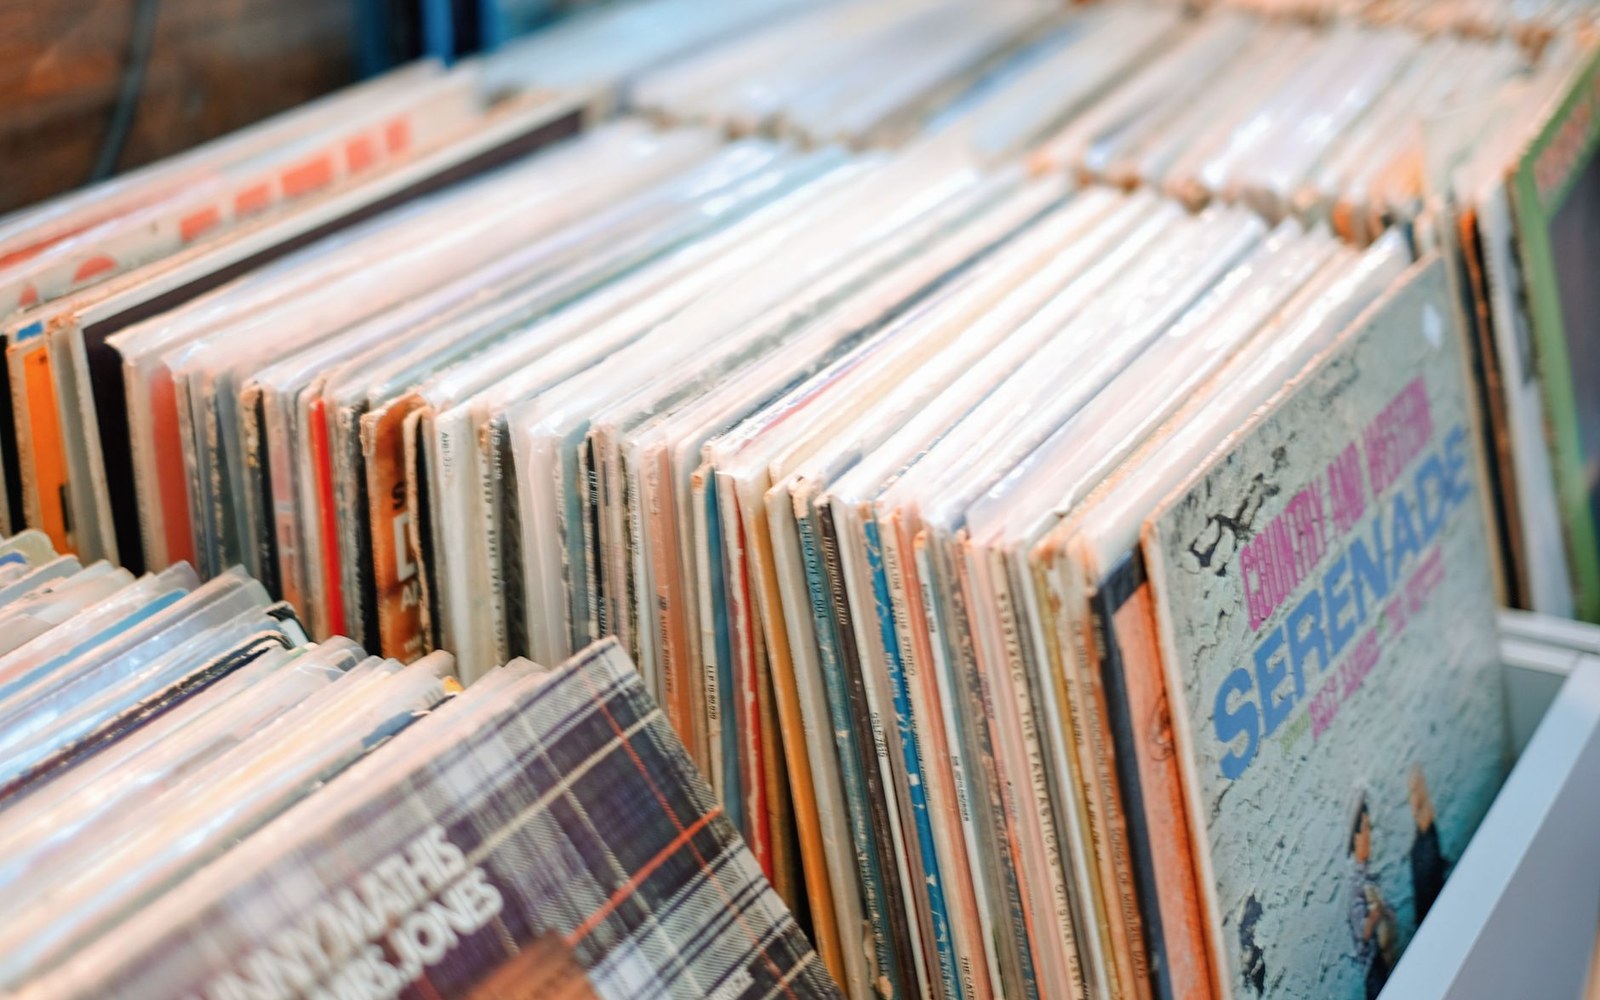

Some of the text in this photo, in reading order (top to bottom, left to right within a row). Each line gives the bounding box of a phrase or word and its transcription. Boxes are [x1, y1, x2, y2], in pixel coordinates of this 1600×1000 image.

[1212, 423, 1472, 780] SERENADE
[1240, 476, 1328, 632] COUNTRY
[1327, 441, 1365, 536] AND
[662, 648, 673, 694] FIDELITY
[885, 546, 901, 590] ASYLUM
[901, 635, 916, 676] STEREO
[1019, 710, 1035, 739] THE
[1030, 751, 1060, 866] FANTASTICKS
[310, 823, 467, 960] MATHIS
[388, 866, 504, 986] JONES
[1099, 772, 1115, 820] RECALLS
[1110, 828, 1123, 864] SONGS
[1123, 893, 1139, 942] MINSTREL
[1134, 950, 1146, 978] DAYS
[959, 956, 971, 974] THE
